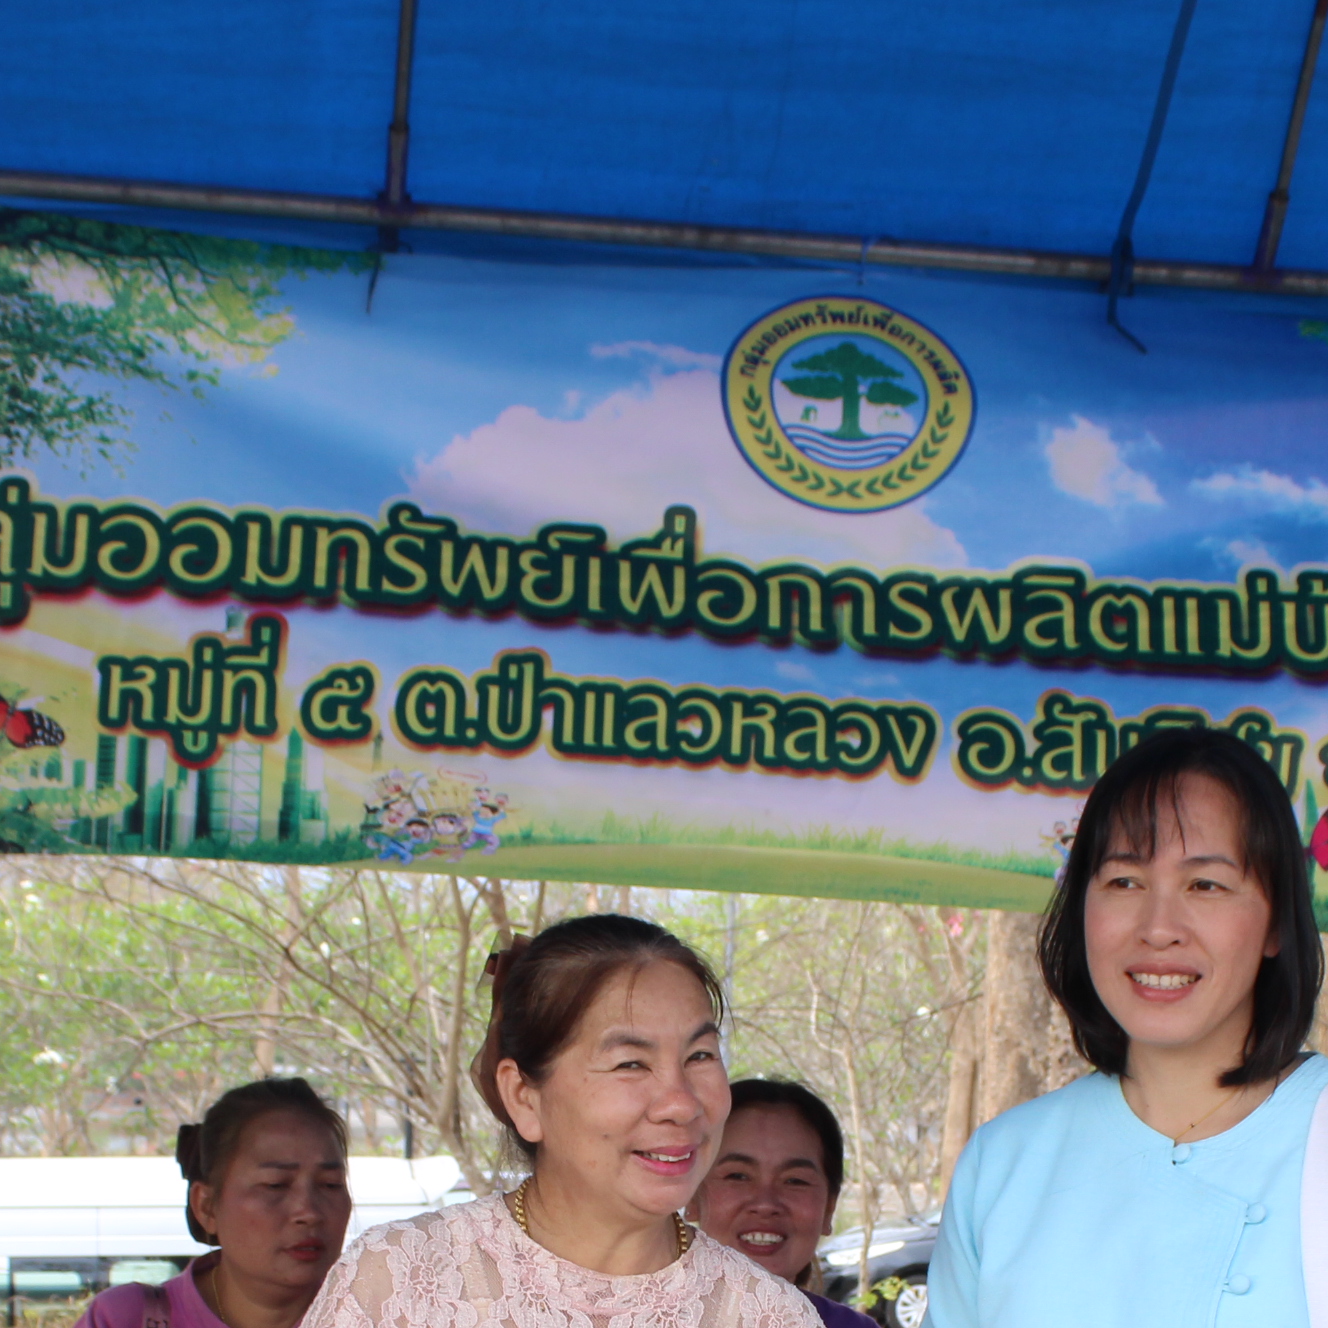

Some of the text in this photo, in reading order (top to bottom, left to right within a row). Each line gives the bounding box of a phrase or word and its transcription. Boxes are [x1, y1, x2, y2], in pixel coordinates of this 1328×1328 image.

[99, 615, 279, 764] หมู่ที่
[301, 665, 375, 741] ๕
[395, 652, 938, 778] ต.ป่าแลวหลวง
